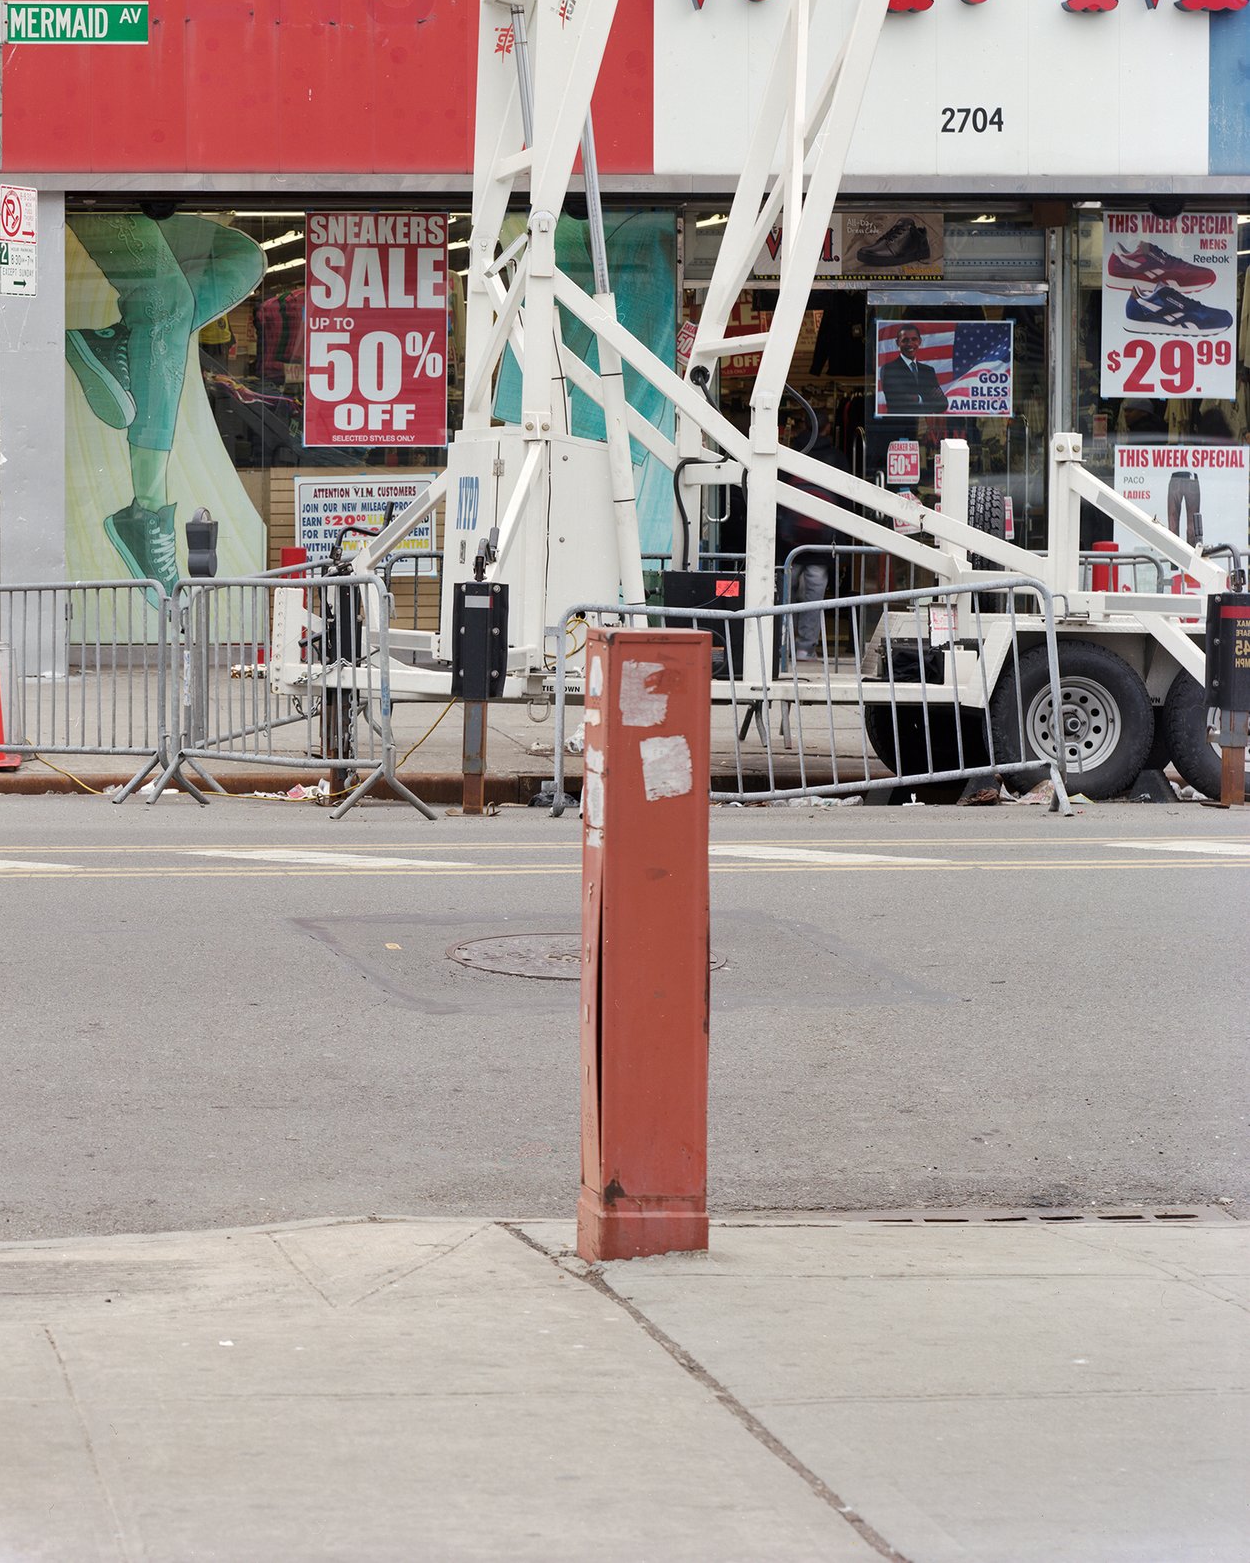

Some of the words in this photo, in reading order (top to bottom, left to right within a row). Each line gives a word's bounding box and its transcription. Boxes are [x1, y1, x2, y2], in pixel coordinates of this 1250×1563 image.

[10, 7, 109, 38] MERMAID
[119, 8, 142, 24] AV
[940, 107, 1005, 134] 2704
[309, 215, 445, 245] SNEAKERS
[1107, 214, 1139, 234] THIS
[1142, 214, 1179, 234] WEEK
[1181, 214, 1235, 235] SPECIAL
[1199, 238, 1227, 250] MENS
[0, 242, 8, 263] 2
[1192, 254, 1230, 264] Reebok
[309, 246, 445, 310] SALE
[309, 317, 330, 330] UP
[334, 317, 355, 330] TO
[309, 331, 443, 402] 50%
[979, 373, 1008, 384] GOD
[971, 386, 1008, 397] BLESS
[950, 399, 1008, 411] AMERICA
[334, 404, 416, 431] OFF
[1118, 449, 1149, 468] THIS
[1152, 449, 1189, 468] WEEK
[1191, 449, 1245, 469] SPECIAL
[1123, 476, 1145, 484] PACO
[313, 487, 350, 499] ATTENTION
[377, 485, 417, 497] CUSTOMERS
[1123, 490, 1151, 500] LADIES
[302, 503, 319, 514] JOIN
[323, 503, 338, 513] OUR
[342, 502, 358, 513] NEW
[361, 501, 387, 512] MILEAG
[456, 476, 480, 530] NYPD
[302, 516, 322, 527] EARN
[302, 529, 319, 539] FOR
[303, 542, 334, 552] WITHI
[397, 539, 430, 549] ONTHS
